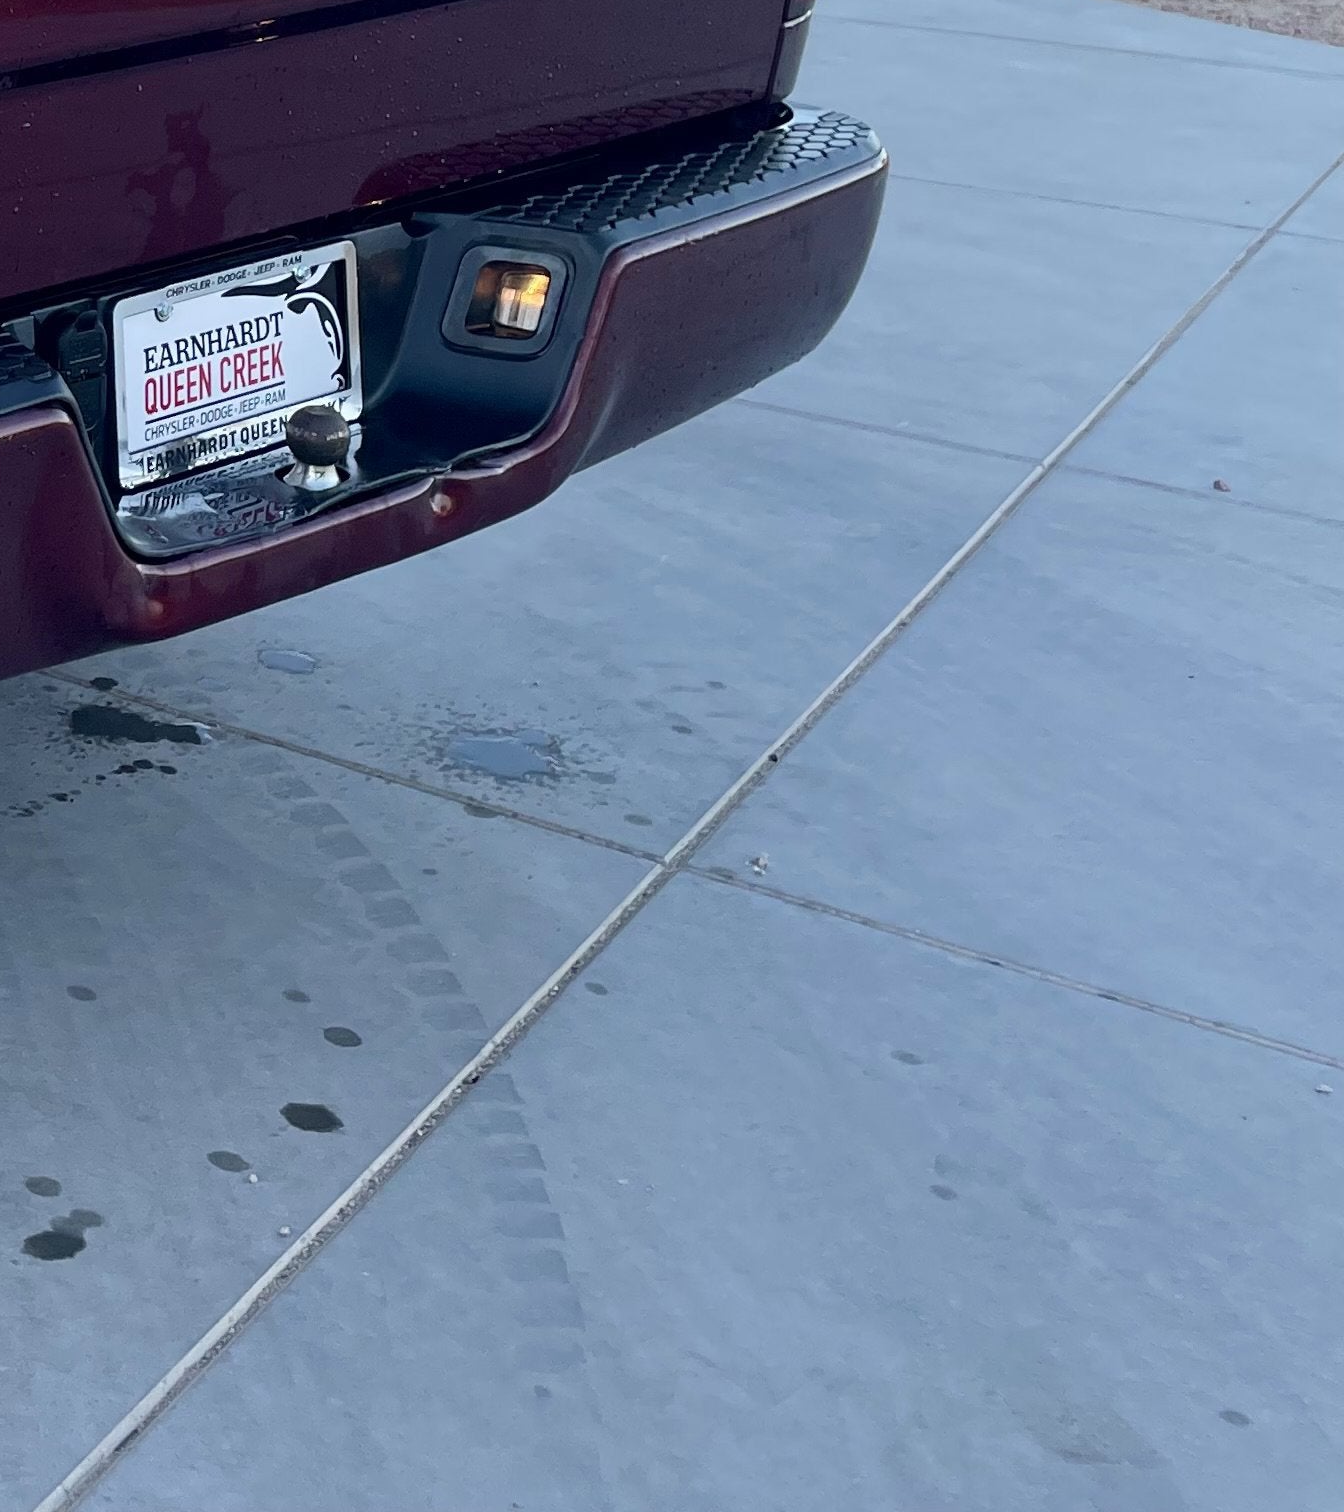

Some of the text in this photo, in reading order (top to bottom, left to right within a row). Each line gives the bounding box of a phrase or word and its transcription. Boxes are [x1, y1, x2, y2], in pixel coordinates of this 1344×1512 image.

[165, 254, 303, 299] CHRYSLER DODGE JEEP RAM
[143, 311, 284, 374] EARNHARDT
[144, 341, 285, 416] QUEEN CREEK
[144, 388, 286, 442] CHRYSLER DODGE JEEP RAM
[146, 414, 288, 474] EARNHARDT QUEEN
